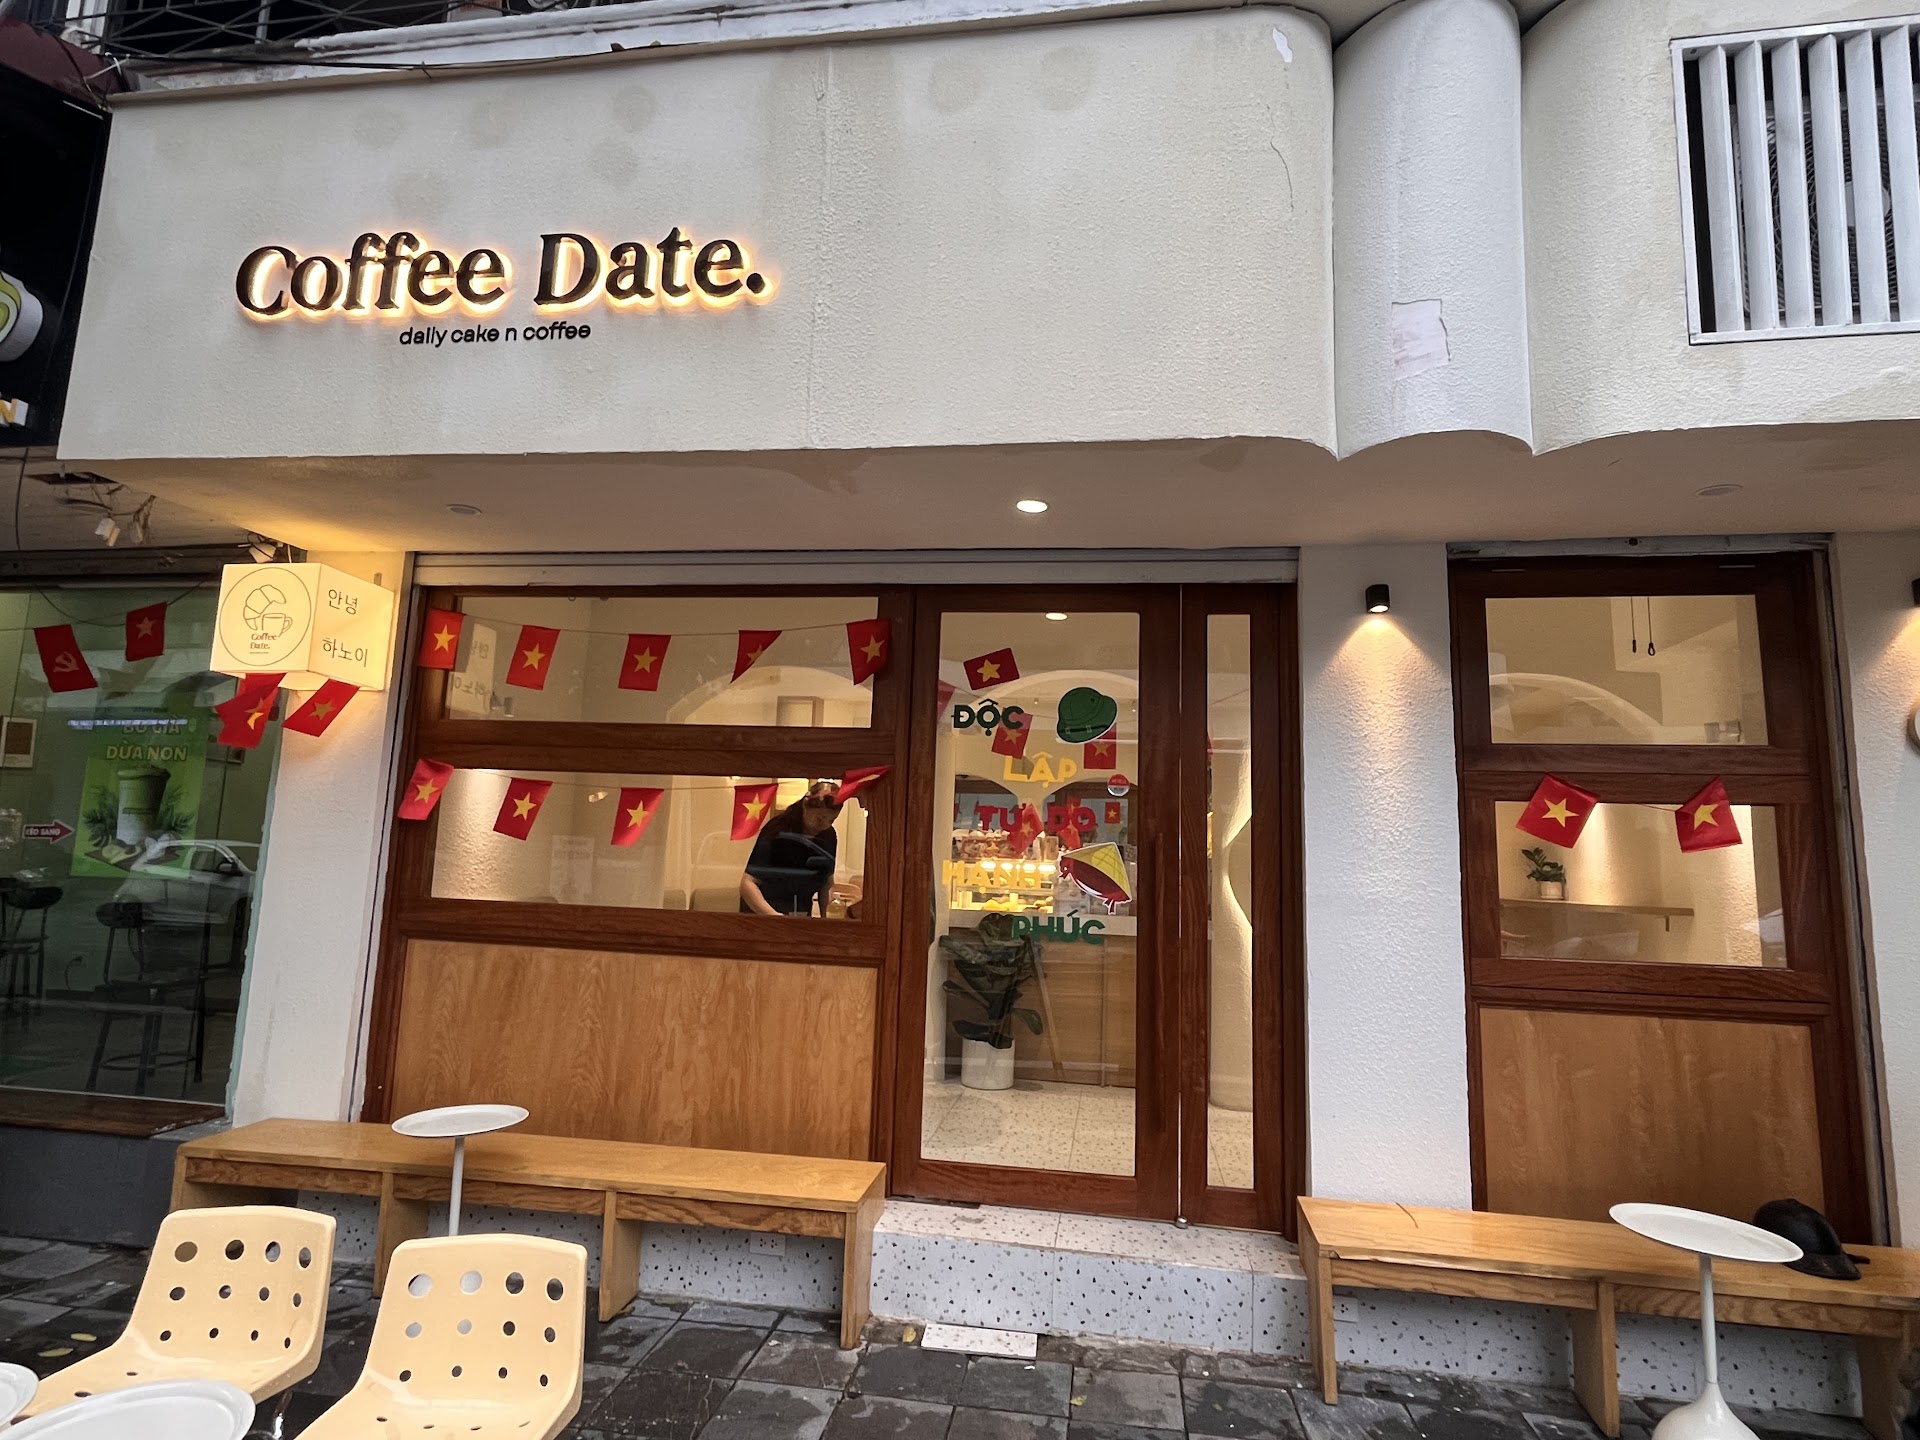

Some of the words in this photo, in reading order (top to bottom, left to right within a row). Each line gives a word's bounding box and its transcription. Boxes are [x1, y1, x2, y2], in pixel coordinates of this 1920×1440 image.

[236, 231, 506, 316] Coffee
[533, 226, 766, 306] Date.
[399, 326, 448, 348] daily
[451, 325, 500, 343] cake
[504, 326, 518, 341] n
[523, 321, 592, 341] coffee
[328, 589, 358, 615] 안녕
[250, 632, 278, 641] Coffee
[322, 637, 369, 668] 하노이
[951, 698, 1025, 737] ĐỘC
[147, 746, 187, 761] NON
[1003, 751, 1078, 788] LẬP
[1046, 803, 1097, 834] DO
[1011, 909, 1106, 945] PHÚC
